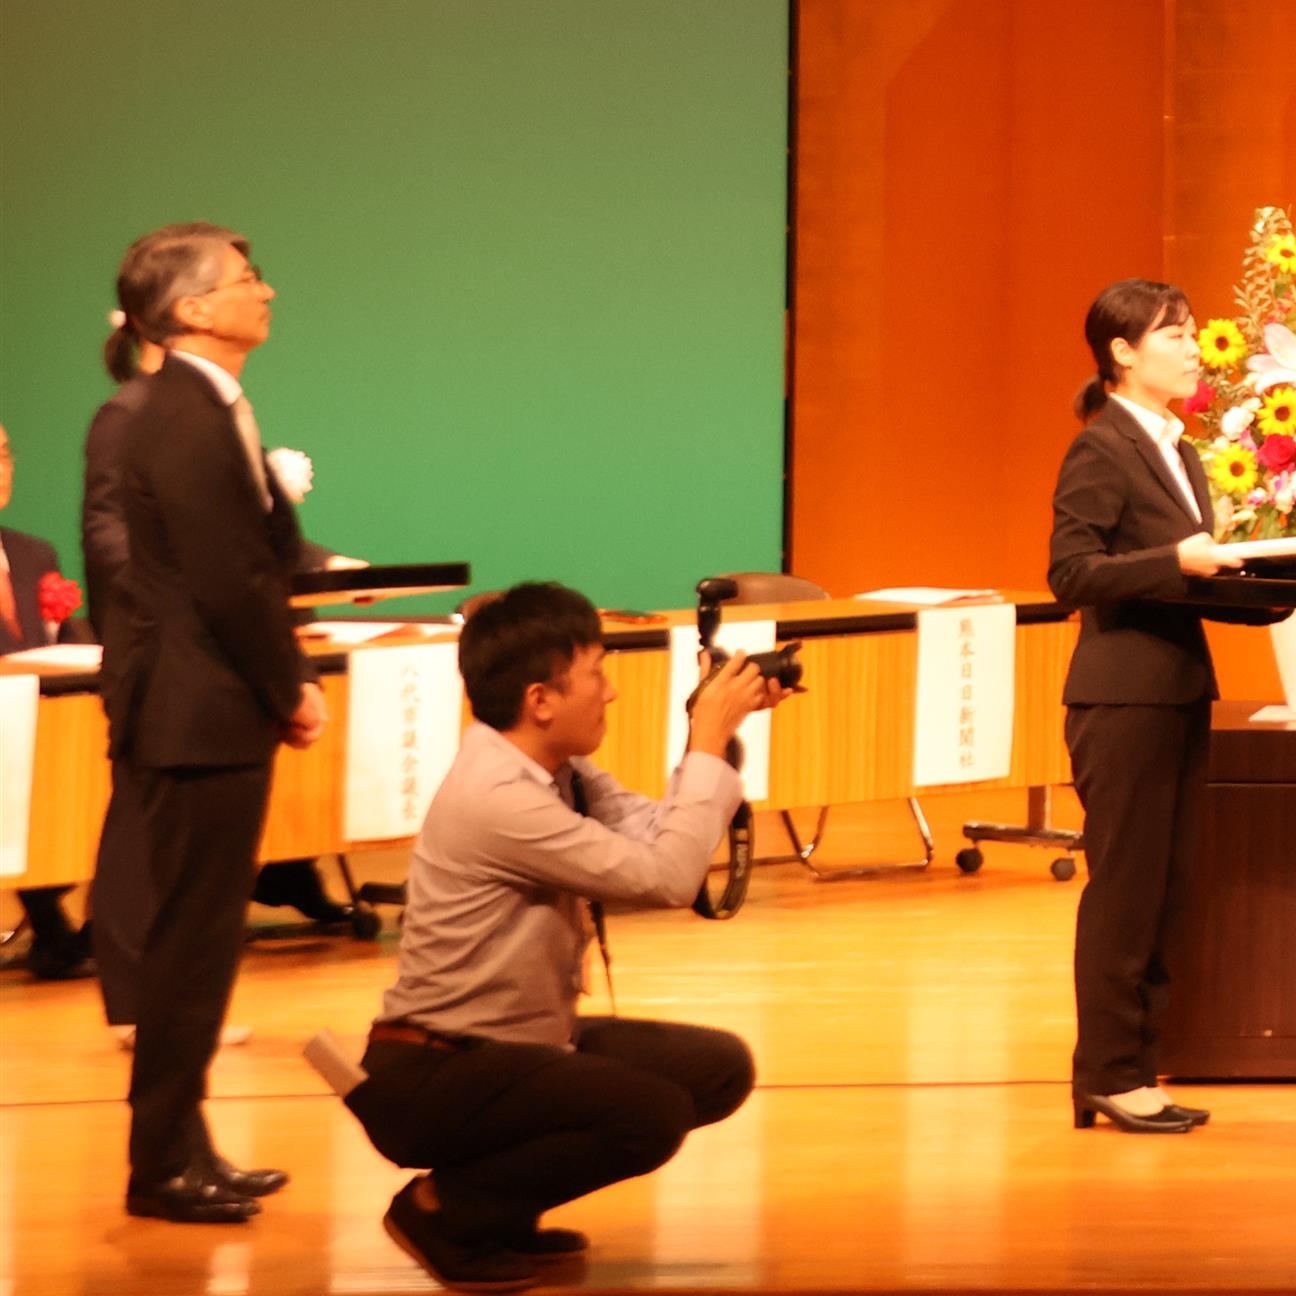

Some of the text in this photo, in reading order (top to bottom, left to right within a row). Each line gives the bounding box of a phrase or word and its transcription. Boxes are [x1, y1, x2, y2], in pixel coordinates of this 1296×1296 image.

[958, 617, 975, 769] 熊本日日新聞社
